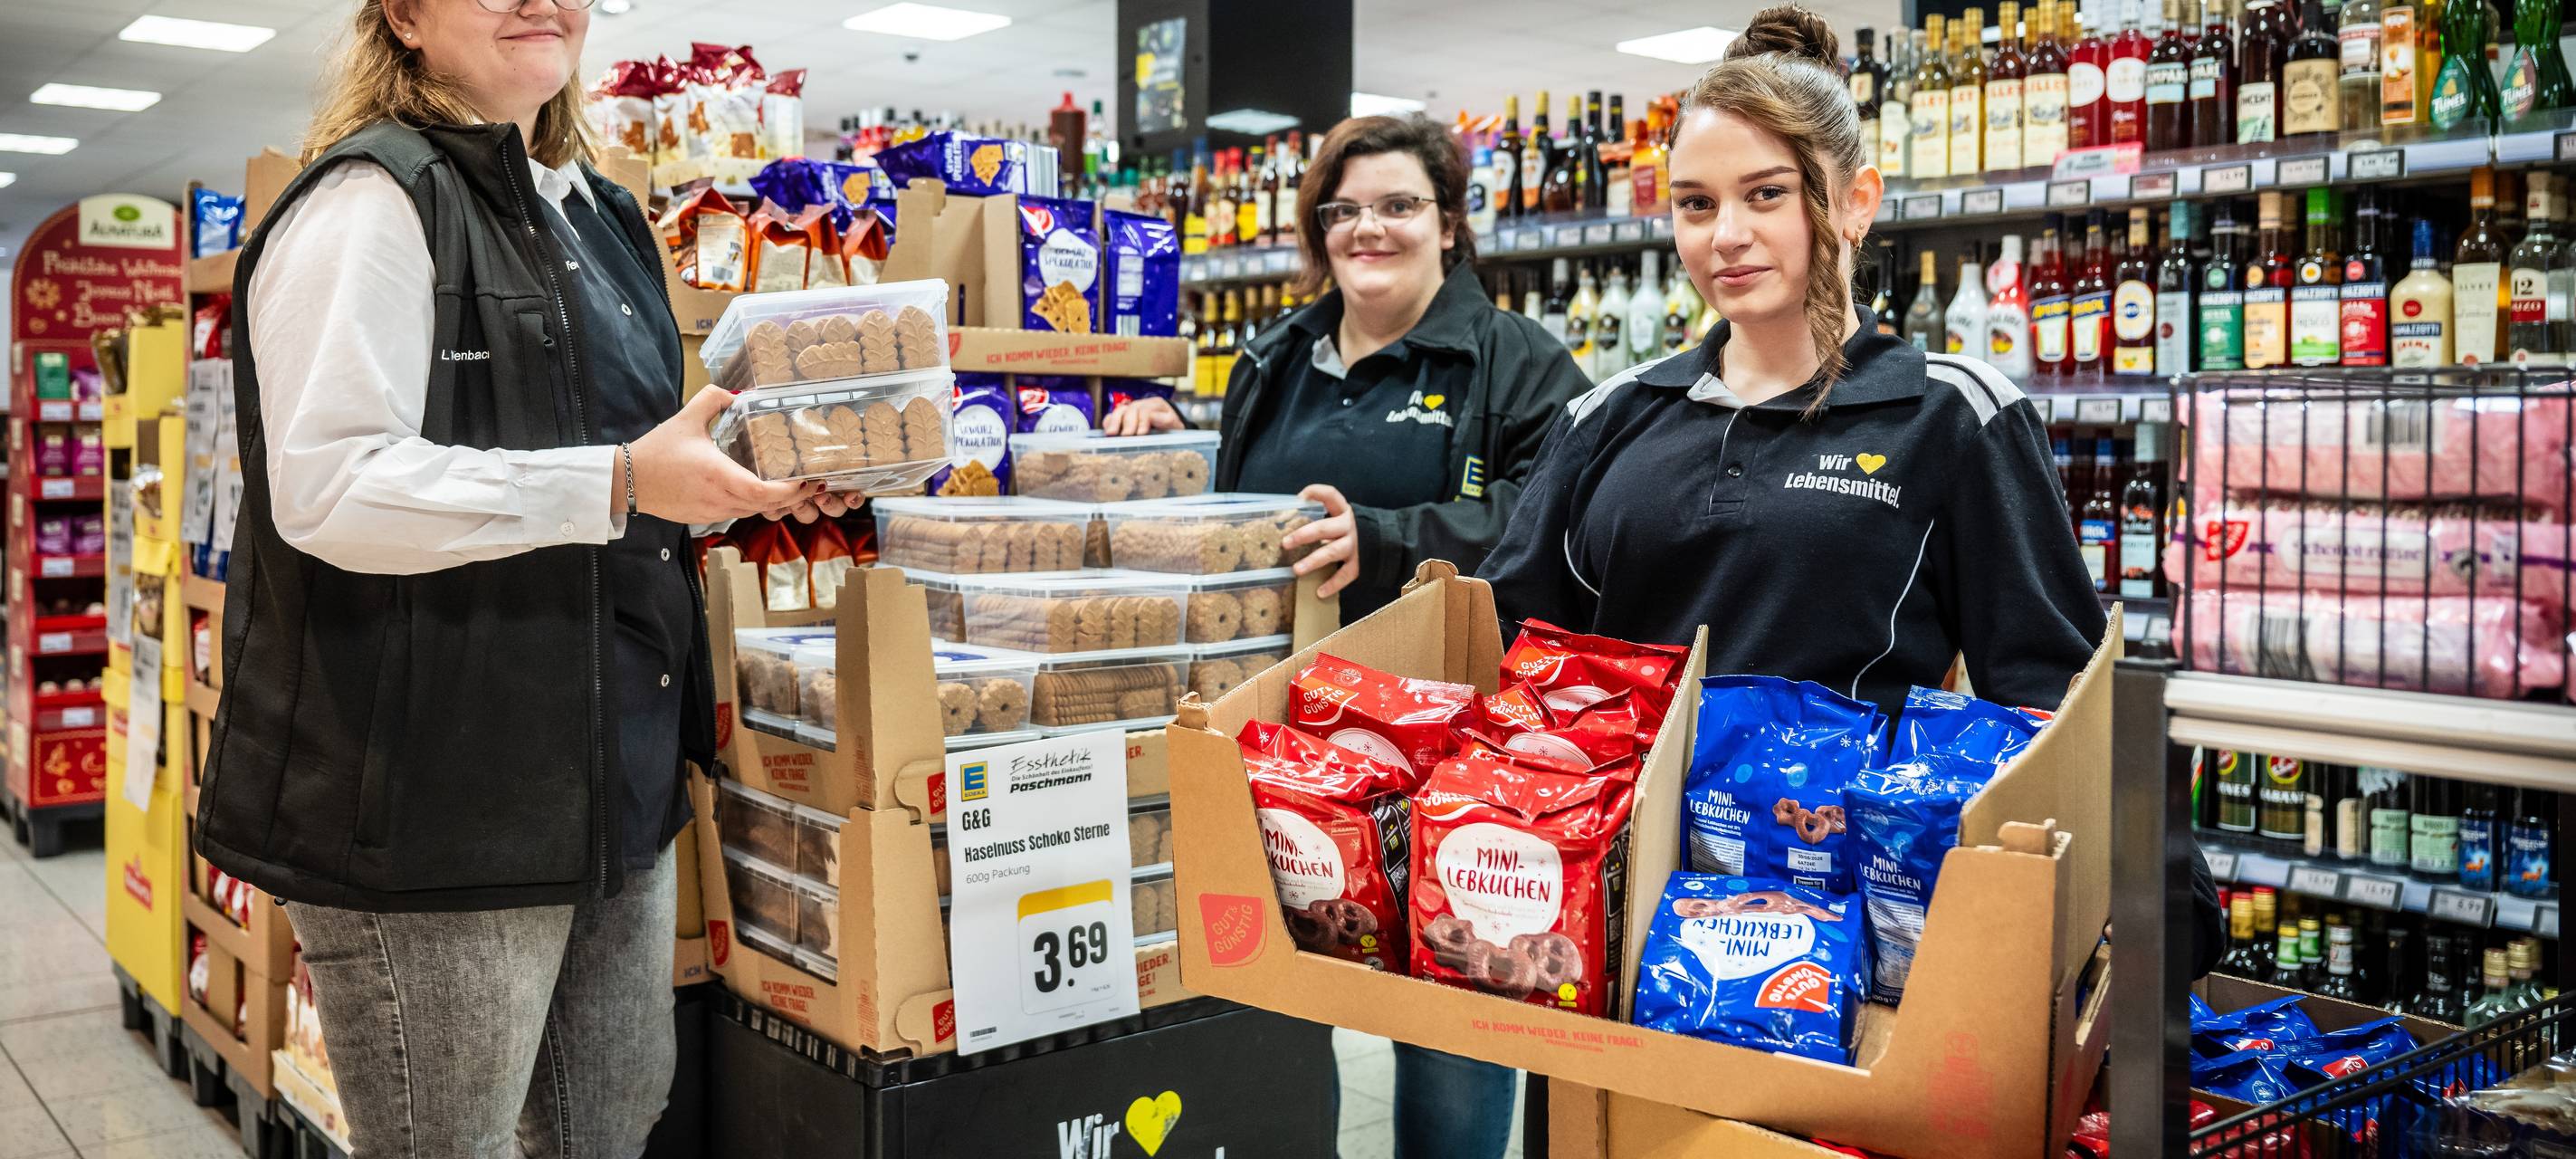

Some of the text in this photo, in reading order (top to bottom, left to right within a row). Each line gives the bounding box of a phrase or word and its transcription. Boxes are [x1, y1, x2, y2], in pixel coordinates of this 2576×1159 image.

[955, 435, 1003, 449] PEKULATIUS
[1819, 455, 1853, 471] Wir
[1708, 789, 1736, 808] MINI-
[962, 808, 991, 831] G&G
[1689, 799, 1751, 825] LEBKUCHEN
[964, 823, 1111, 863] Haselnuss Schoko Sterne
[1264, 828, 1304, 857] MINI-
[1269, 851, 1334, 878] KUCHEN
[1476, 847, 1525, 874] MINI-
[1872, 854, 1903, 874] MINI-
[966, 864, 1031, 885] 600g Packung
[1447, 867, 1550, 903] LEBKUCHEN
[1214, 904, 1253, 953] GÜNSTIG
[1693, 917, 1803, 940] LEBKUCHEN
[1721, 939, 1770, 957] MINI-
[1472, 1019, 1489, 1030] ICH
[1492, 1022, 1524, 1035] KOMM
[1573, 1031, 1605, 1044] KEINE
